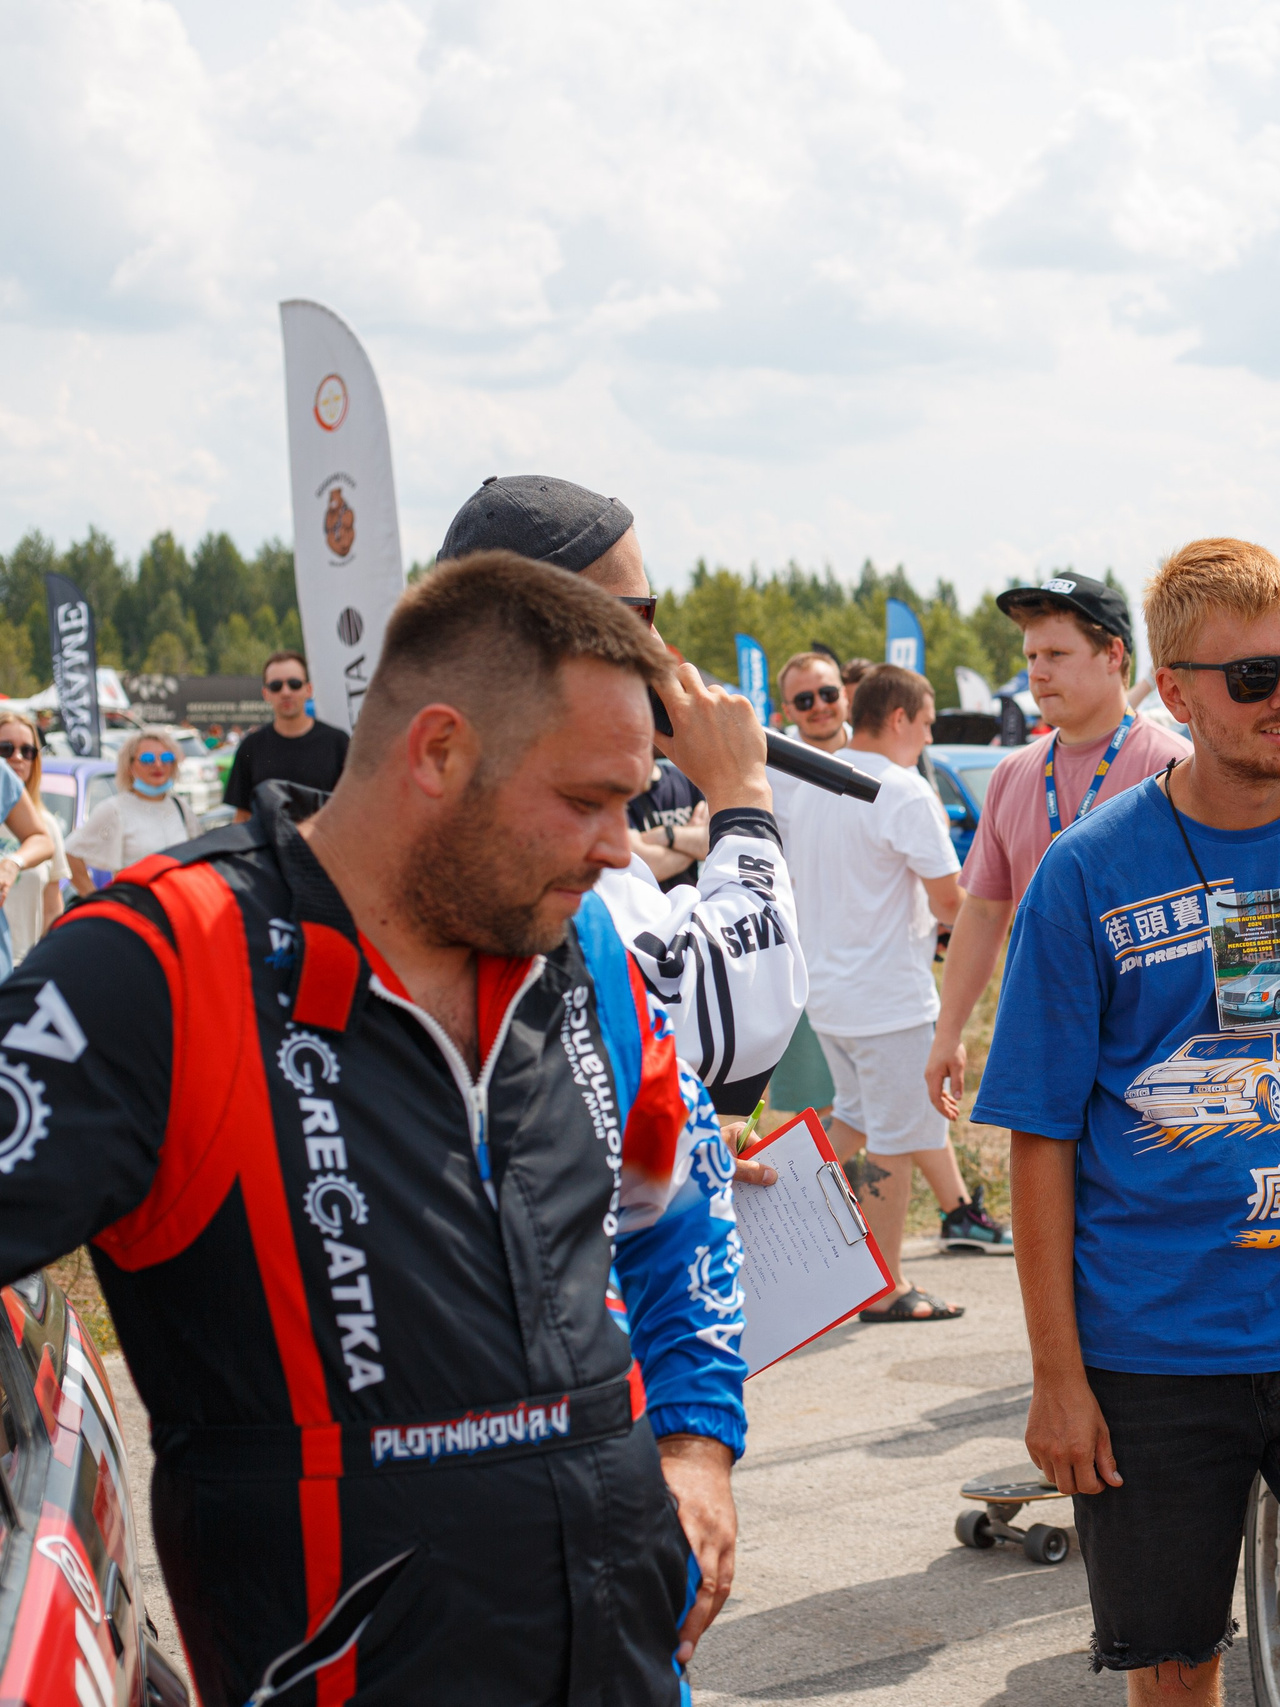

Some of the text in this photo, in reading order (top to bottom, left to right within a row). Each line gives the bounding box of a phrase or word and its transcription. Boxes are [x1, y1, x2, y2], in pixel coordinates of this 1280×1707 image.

[1105, 887, 1235, 951] 街頭賽
[1227, 941, 1257, 949] MERCEDES
[581, 1091, 605, 1139] BMW
[277, 1018, 387, 1393] GREGATKA
